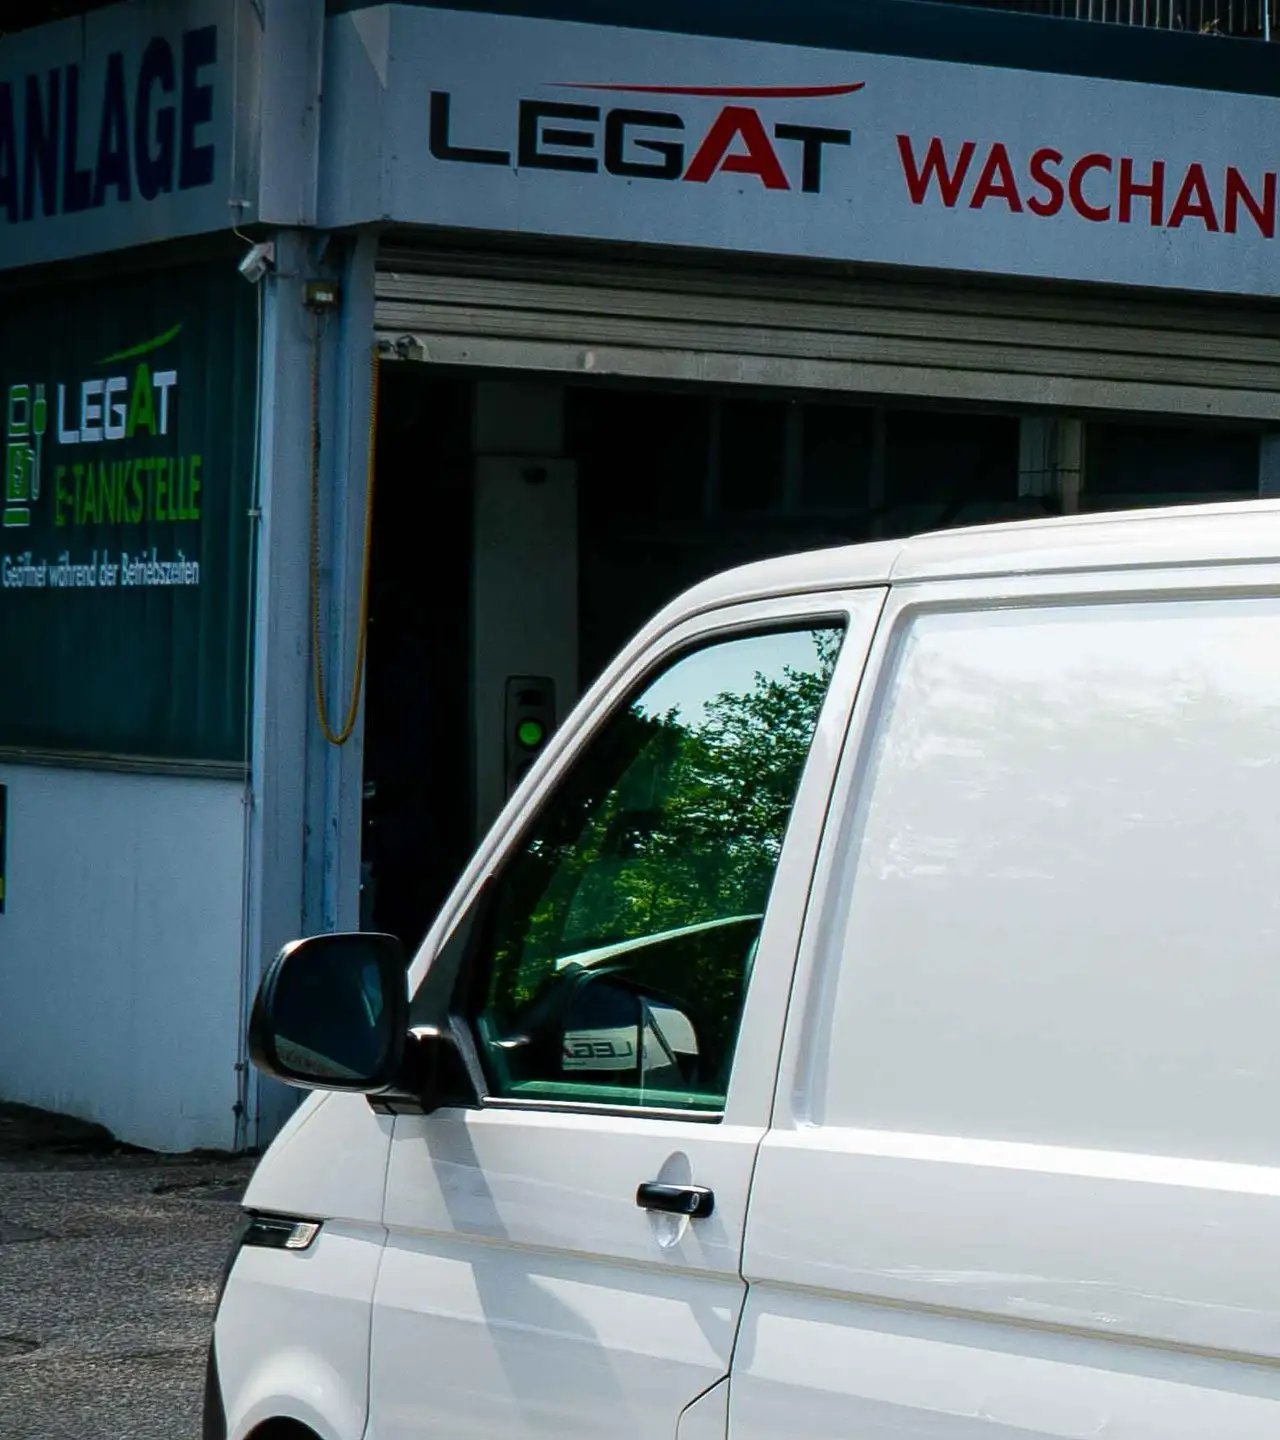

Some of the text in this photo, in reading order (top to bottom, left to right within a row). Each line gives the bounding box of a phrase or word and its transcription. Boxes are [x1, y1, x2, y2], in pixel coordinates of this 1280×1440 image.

[429, 89, 852, 194] LEGAT
[58, 362, 177, 444] LEGAT
[54, 455, 201, 527] E-TANKSTELLE
[2, 547, 200, 587] Geöffnet während der Betriebszeiten
